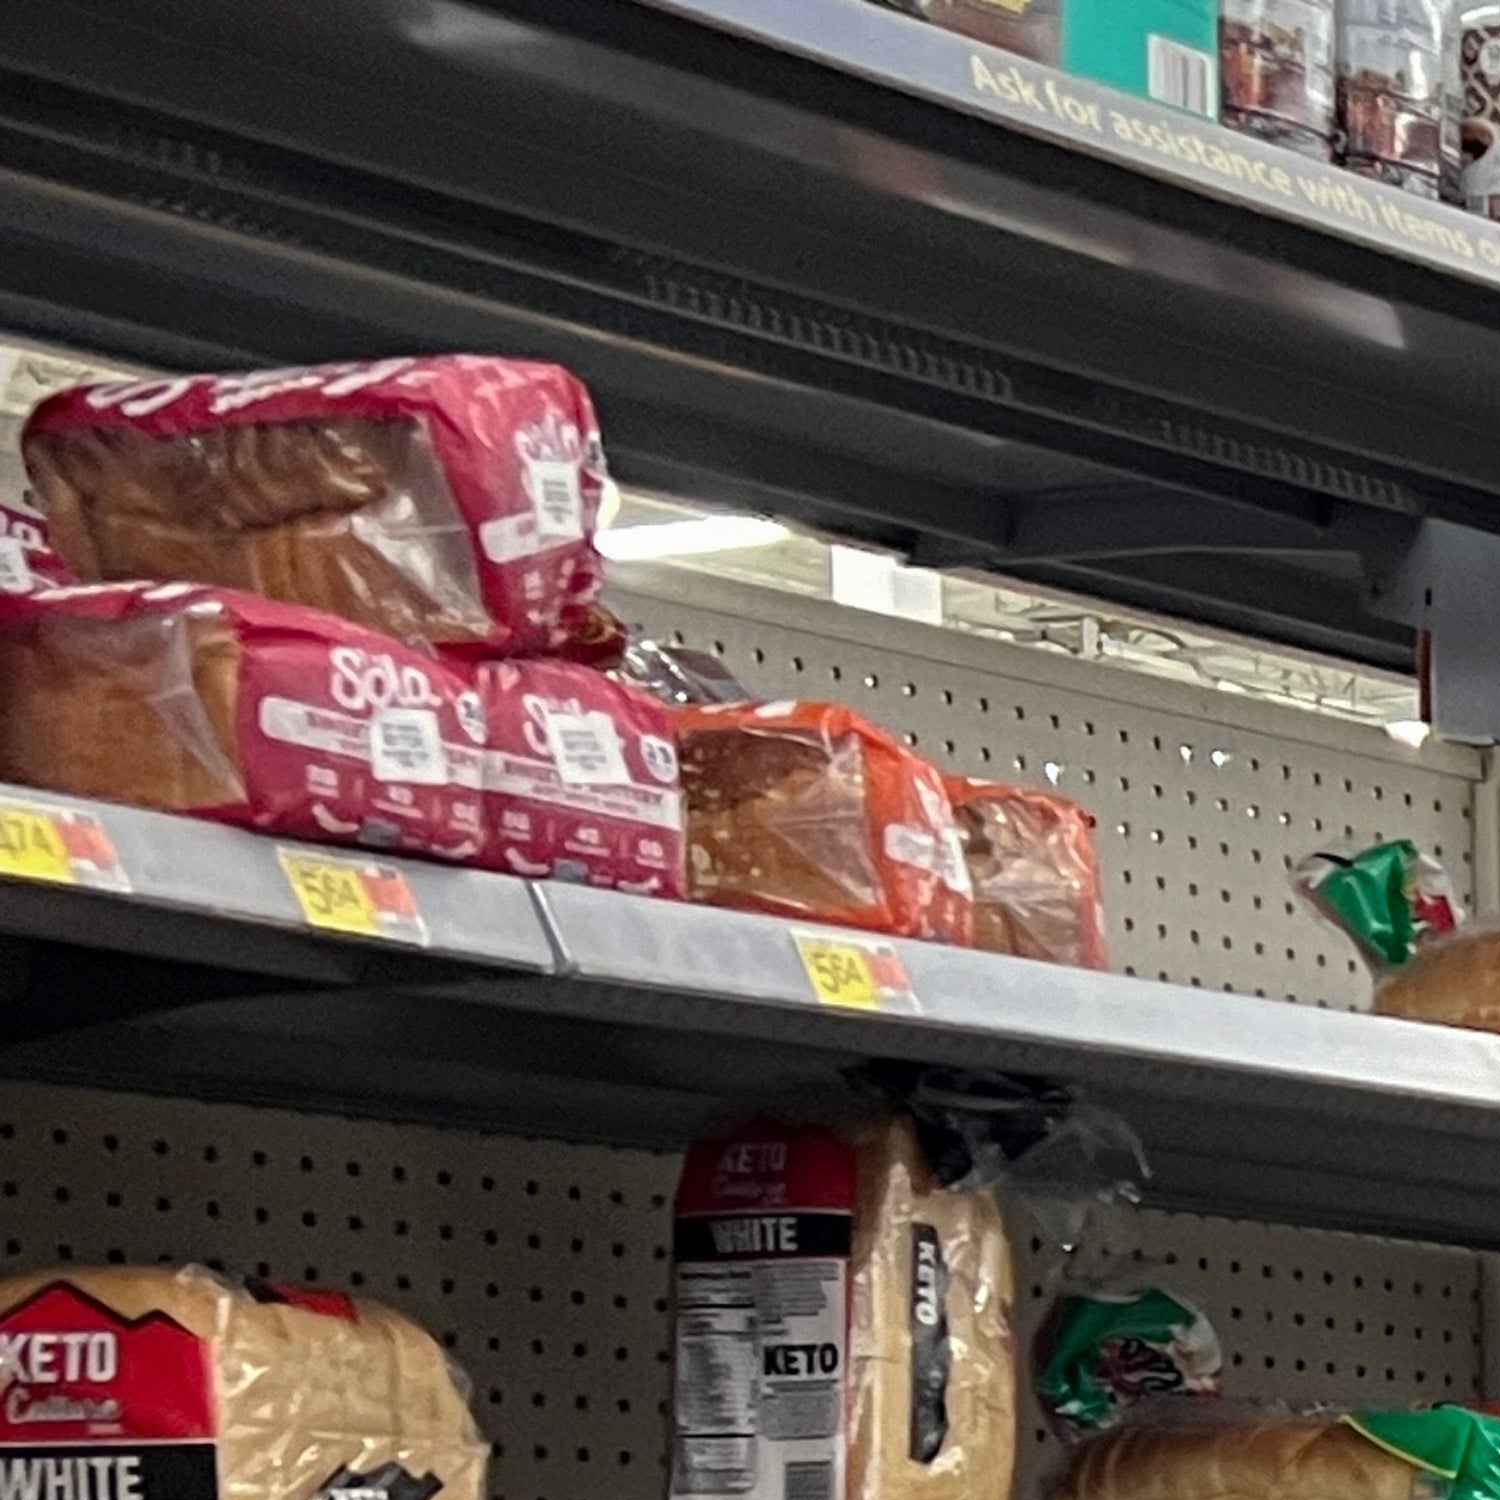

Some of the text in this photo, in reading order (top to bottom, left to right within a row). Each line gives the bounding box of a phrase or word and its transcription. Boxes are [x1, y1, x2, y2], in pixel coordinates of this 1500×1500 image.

[970, 55, 1046, 112] Ask
[1045, 80, 1103, 133] for
[1108, 110, 1296, 197] assistance
[1297, 176, 1375, 224] with
[1377, 195, 1474, 260] items
[709, 1216, 799, 1253] WHITE
[914, 1240, 939, 1326] KETO
[0, 1331, 117, 1384] KETO
[762, 1343, 839, 1377] KETO
